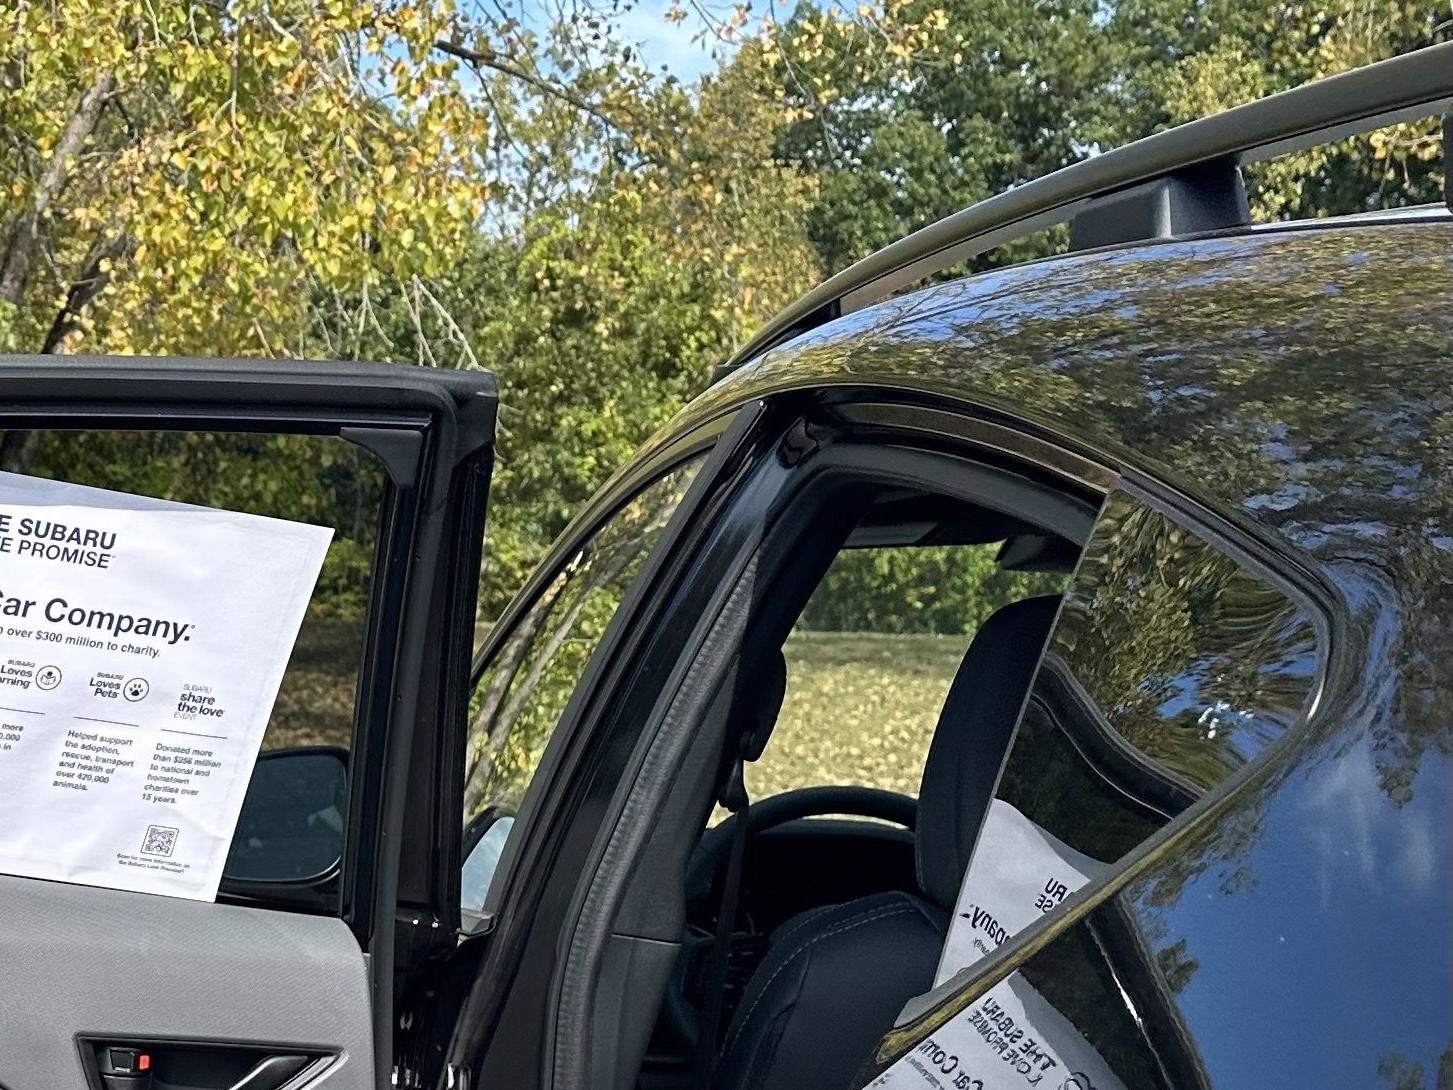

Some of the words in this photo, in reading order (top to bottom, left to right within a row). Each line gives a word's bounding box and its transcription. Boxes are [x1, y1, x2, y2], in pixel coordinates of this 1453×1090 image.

[18, 518, 117, 550] SUBARU
[7, 628, 33, 638] over
[35, 630, 63, 643] $300
[65, 636, 104, 649] million
[107, 642, 118, 651] to
[121, 644, 160, 658] charity.
[0, 665, 32, 678] Loves
[89, 678, 121, 689] Loves
[94, 688, 119, 698] Pets
[180, 692, 216, 706] share
[177, 702, 198, 714] the
[198, 705, 226, 718] love
